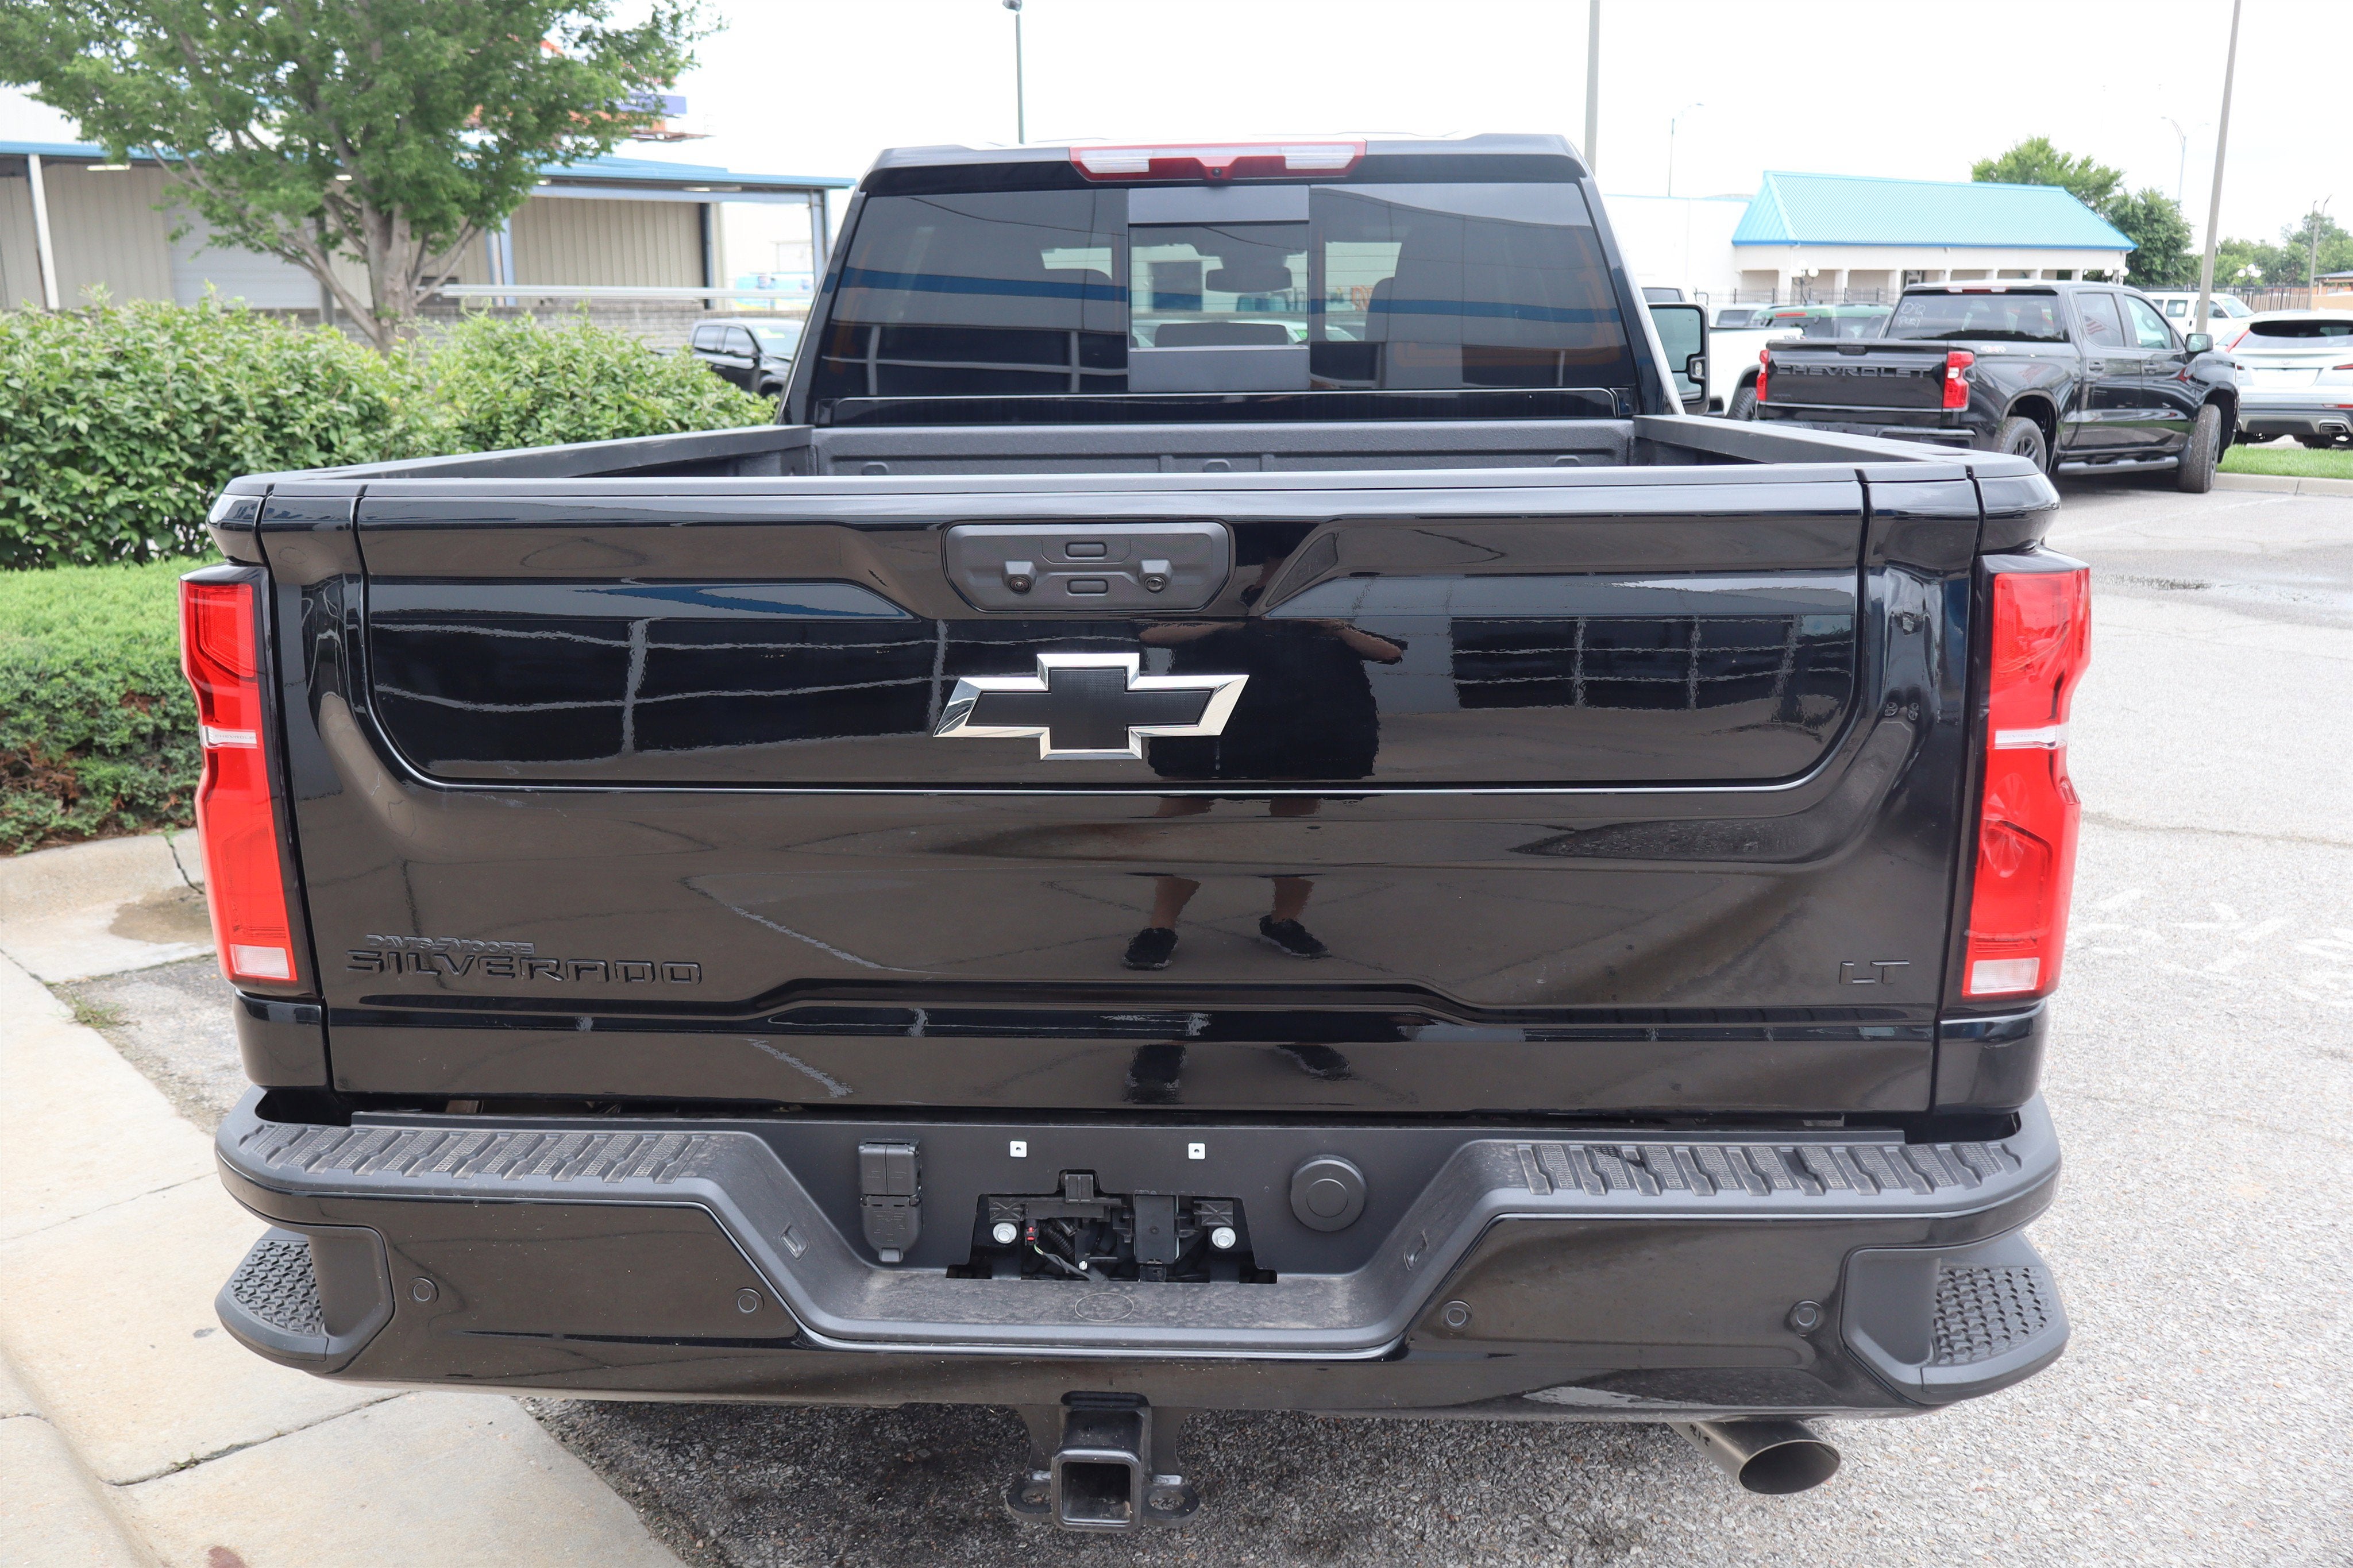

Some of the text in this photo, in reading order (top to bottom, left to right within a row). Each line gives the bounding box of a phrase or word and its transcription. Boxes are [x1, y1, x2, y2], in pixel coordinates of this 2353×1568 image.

[1777, 364, 1932, 379] CHEVROLET
[346, 949, 702, 984] SILVERADO
[1839, 960, 1910, 985] LT
